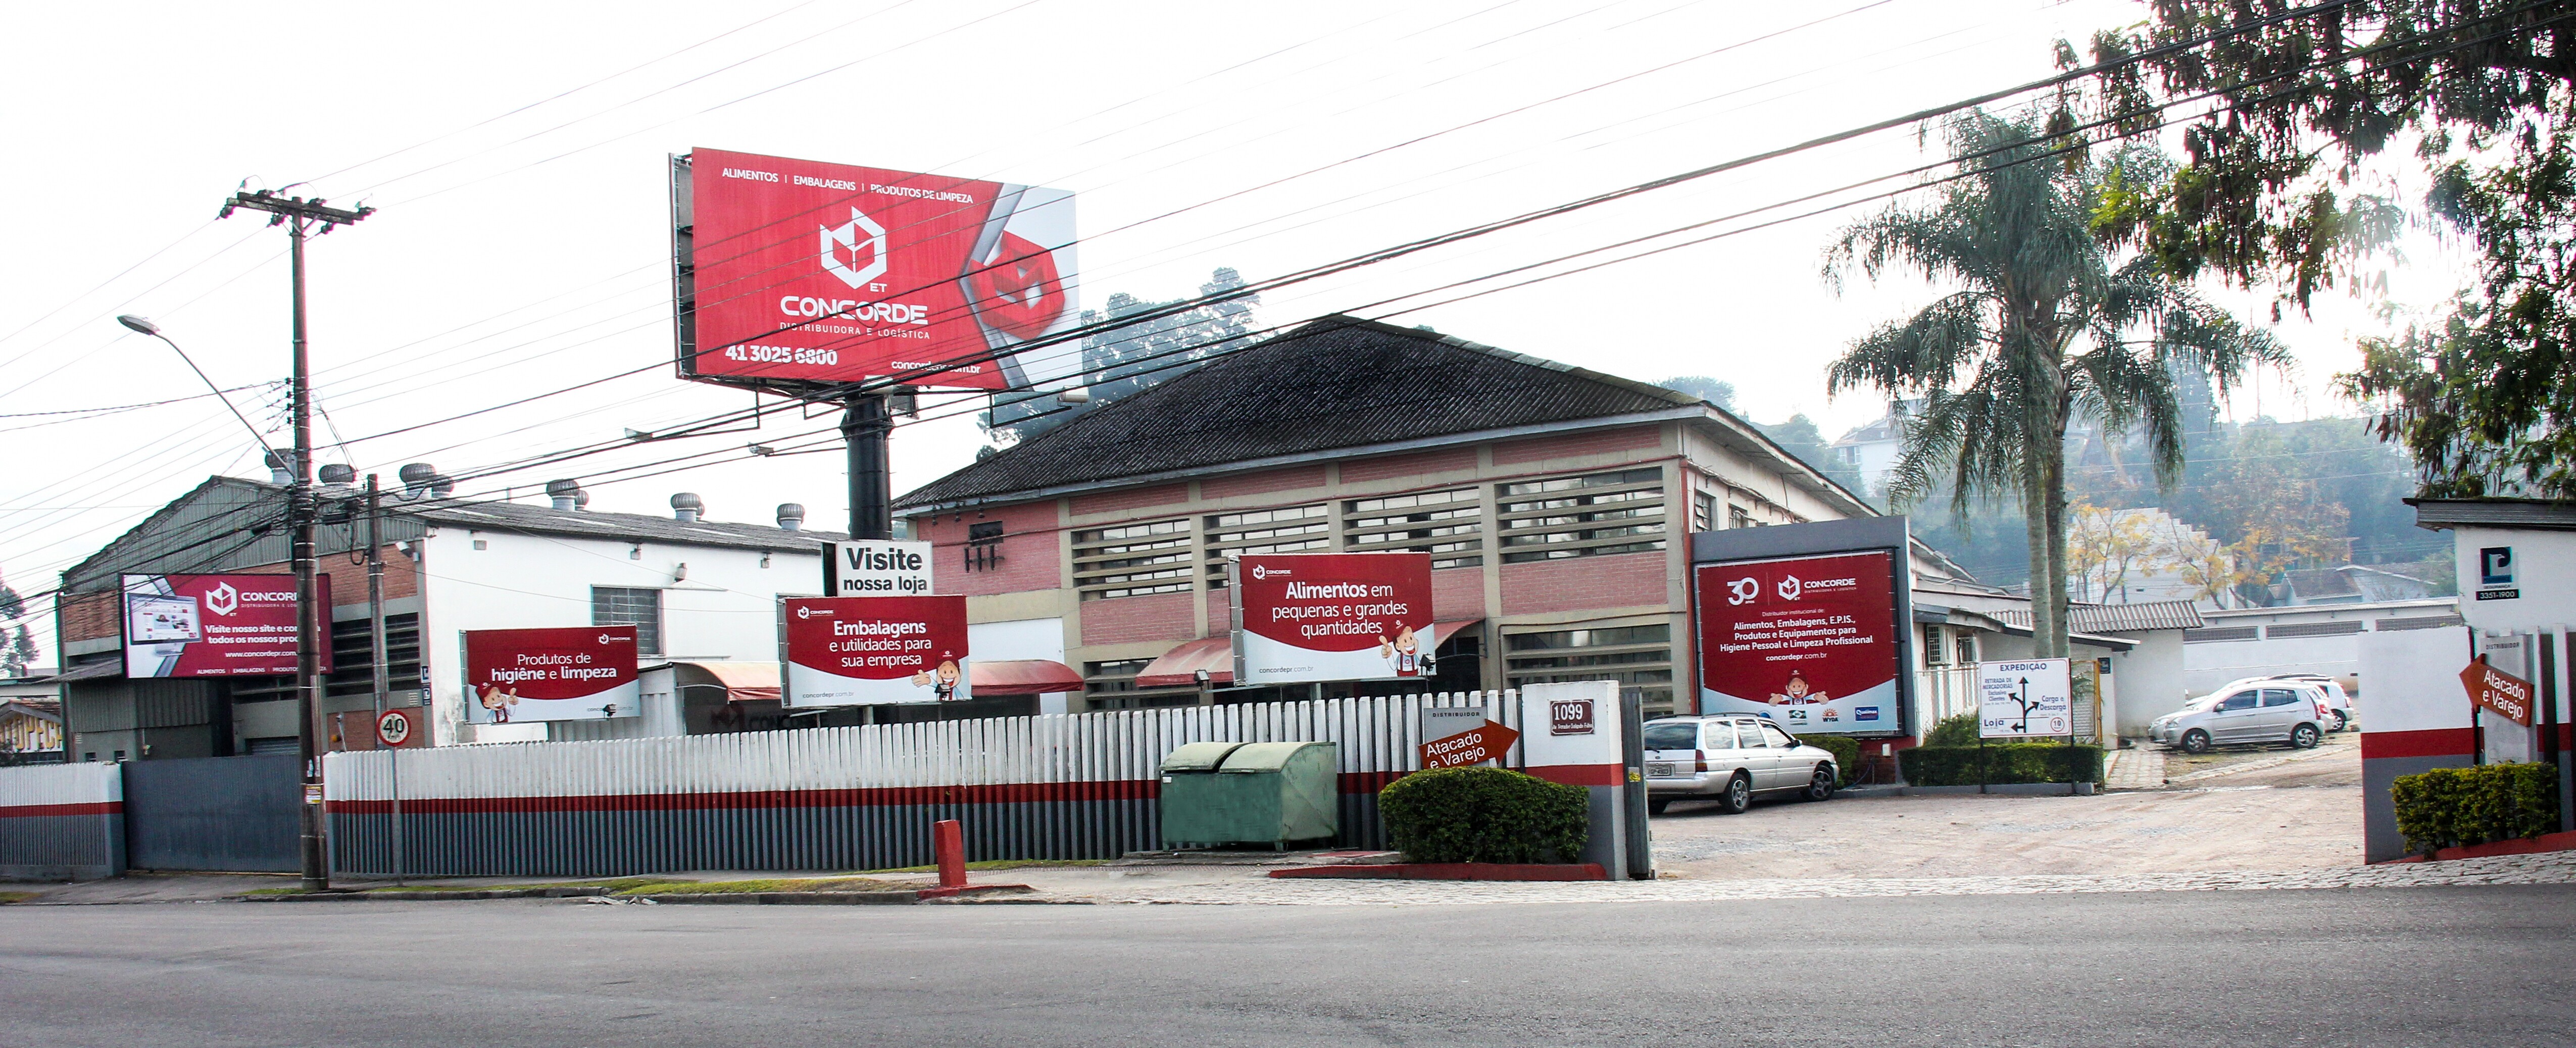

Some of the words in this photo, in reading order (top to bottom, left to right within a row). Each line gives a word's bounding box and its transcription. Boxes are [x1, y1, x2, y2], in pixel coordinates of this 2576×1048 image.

[722, 168, 778, 182] ALIMENTOS
[794, 175, 856, 191] EMBALAGENS
[870, 183, 921, 198] PRODUTOS
[922, 189, 935, 199] DE
[936, 191, 973, 204] LIMPEZA
[870, 283, 887, 292] ET
[780, 295, 928, 325] CONCORDE
[780, 322, 861, 335] DISTRIBUIDORA
[878, 328, 930, 339] LOGÍSTICA
[725, 344, 747, 361] 41
[750, 345, 791, 363] 3025
[795, 348, 837, 365] 6800
[846, 547, 922, 571] Visite
[844, 578, 893, 590] nossa
[899, 576, 927, 594] loja
[1285, 581, 1367, 600] Alimentos
[1371, 585, 1393, 597] em
[1727, 577, 1759, 606] 30
[1804, 578, 1856, 589] CONCORDE
[241, 592, 298, 602] CONCOR
[1272, 605, 1339, 622] pequenas
[1343, 605, 1351, 616] e
[1355, 600, 1407, 619] grandes
[205, 625, 231, 633] Visite
[260, 624, 275, 632] site
[834, 620, 926, 638] Embalagens
[1301, 620, 1382, 640] quantidades
[1734, 621, 1775, 631] Alimentos,
[1777, 618, 1828, 630] Embalagens,
[208, 636, 234, 644] todos
[1735, 631, 1771, 641] Produtos
[1779, 627, 1837, 639] Equipamentos
[1839, 627, 1856, 636] para
[829, 642, 837, 652] e
[841, 638, 901, 652] utilidades
[905, 639, 932, 653] para
[1720, 642, 1750, 654] Higiene
[1752, 640, 1781, 650] Pessoal
[1790, 637, 1824, 649] Limpeza
[1825, 635, 1873, 646] Profissional
[517, 654, 572, 666] Produtos
[575, 653, 591, 664] de
[841, 657, 864, 667] sua
[867, 655, 922, 669] empresa
[1766, 652, 1827, 662] concordepr.com.br
[491, 667, 546, 684] higiêne
[550, 670, 557, 679] e
[561, 666, 617, 681] limpeza
[1259, 665, 1314, 674] concordepr.com.br
[2483, 670, 2525, 700] Atacado
[803, 690, 854, 698] concordepr.com.br
[2042, 695, 2059, 703] Carga
[1554, 704, 1583, 720] 1099
[2483, 690, 2489, 702] e
[2492, 690, 2523, 720] Varejo
[383, 719, 404, 733] 40
[1984, 718, 2004, 727] Loja
[1426, 732, 1482, 758] Atacado
[1429, 759, 1439, 769] e
[1440, 745, 1485, 767] Varejo
